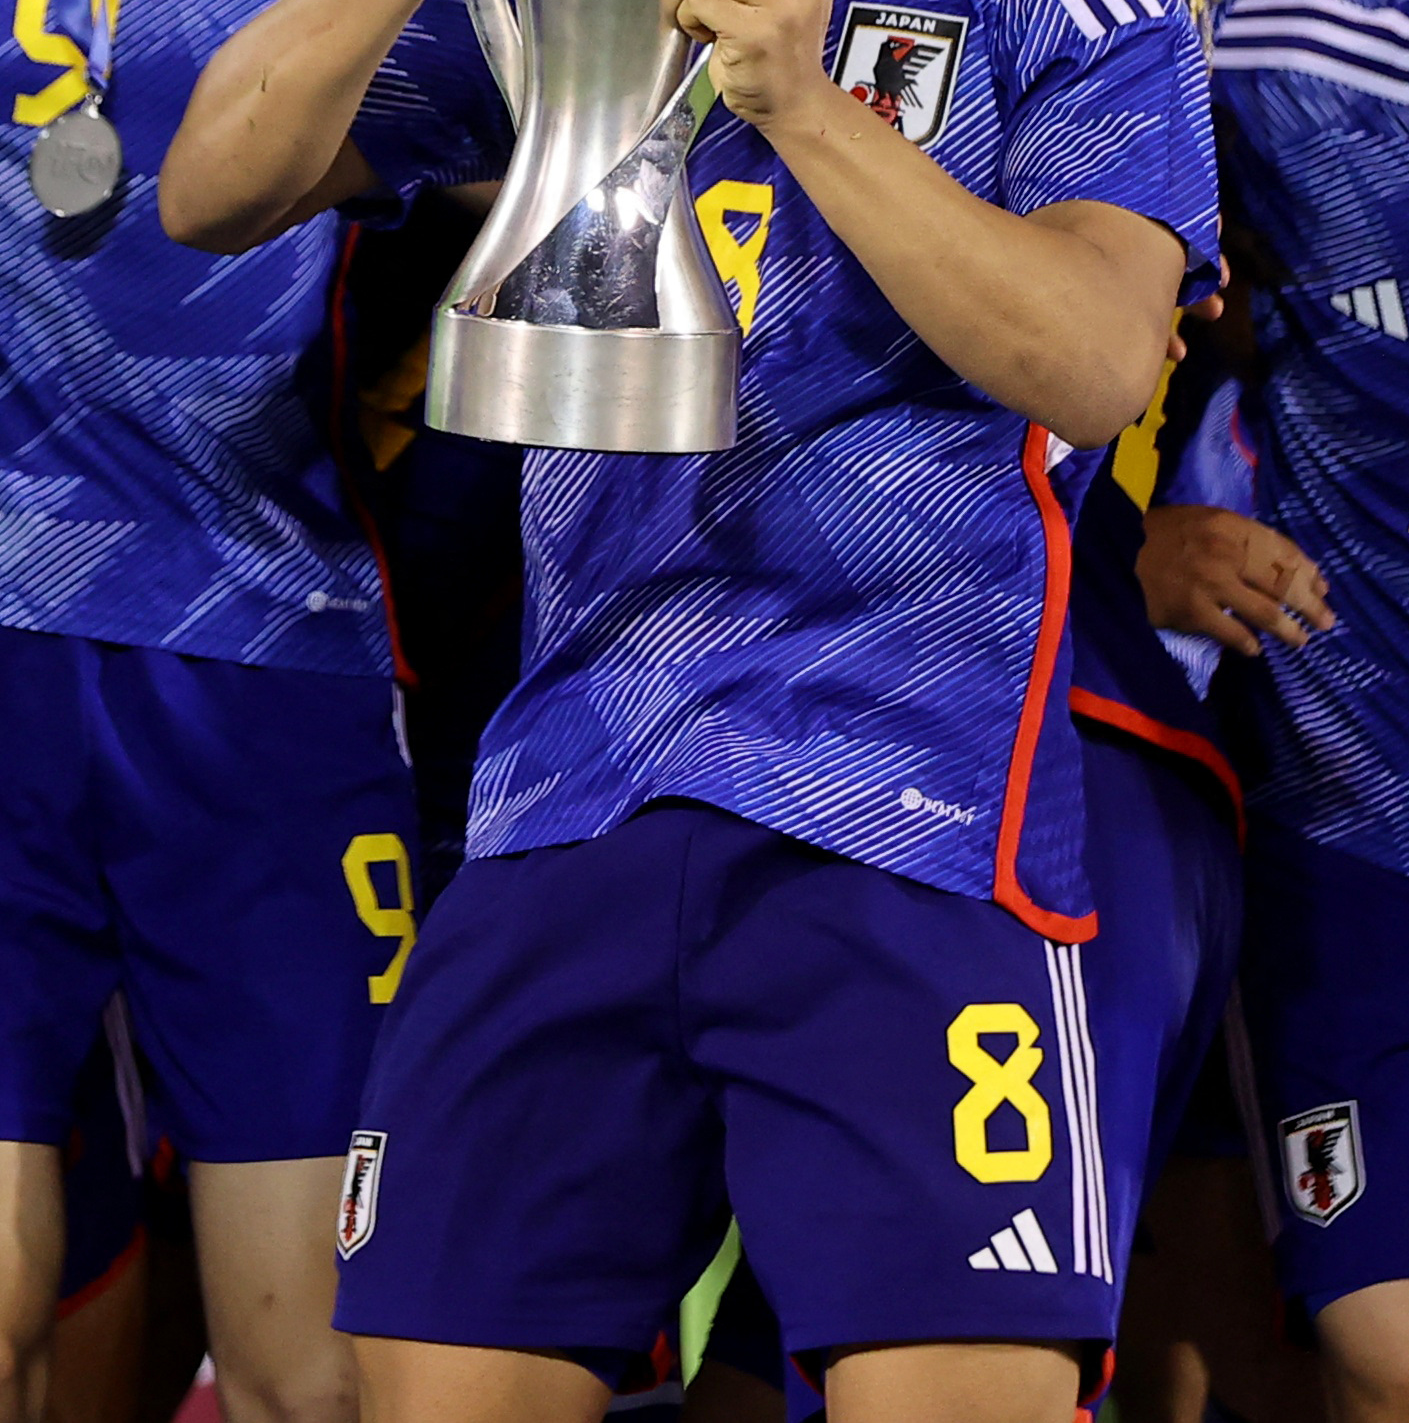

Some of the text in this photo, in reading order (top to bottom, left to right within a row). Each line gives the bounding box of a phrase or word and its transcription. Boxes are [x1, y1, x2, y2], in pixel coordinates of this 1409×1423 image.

[875, 12, 937, 33] JAPAN
[340, 833, 418, 1005] 9
[947, 1003, 1052, 1183] 8
